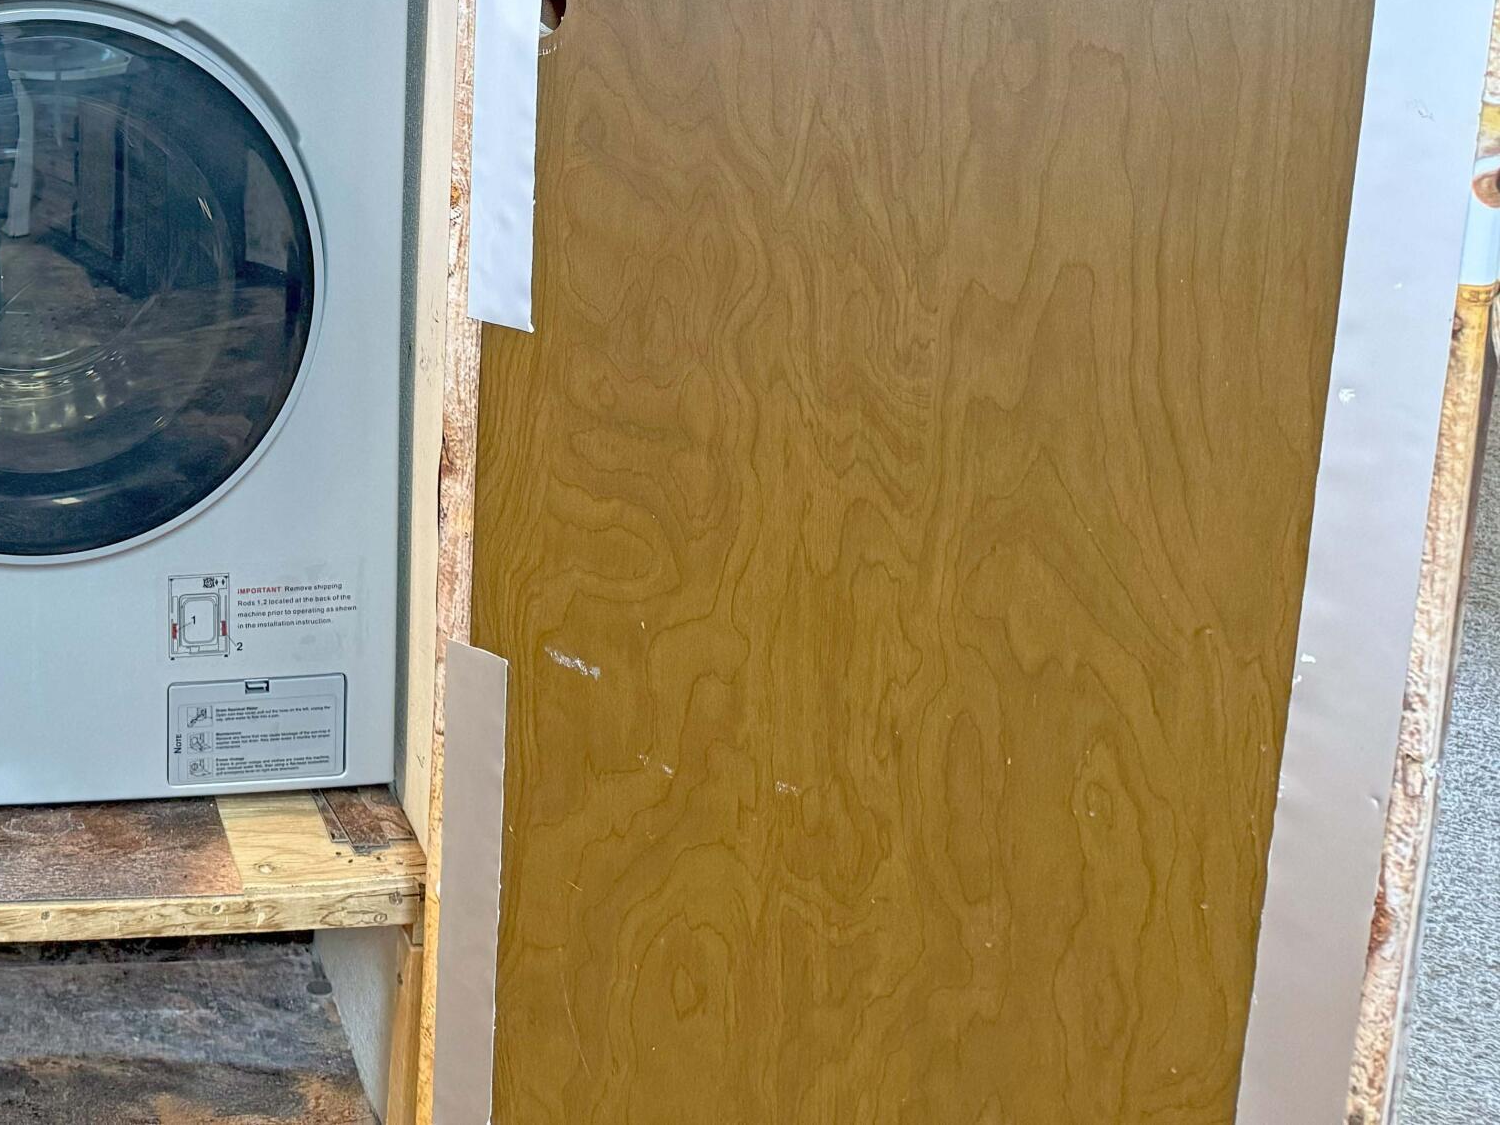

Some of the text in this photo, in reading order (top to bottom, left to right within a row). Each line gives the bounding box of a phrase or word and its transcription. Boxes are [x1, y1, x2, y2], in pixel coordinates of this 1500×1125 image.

[313, 583, 342, 591] shipping
[237, 610, 266, 618] machine
[293, 607, 325, 615] operating
[192, 615, 197, 624] 1
[257, 620, 295, 628] installation
[236, 641, 243, 651] 2
[174, 733, 182, 754] NOTE
